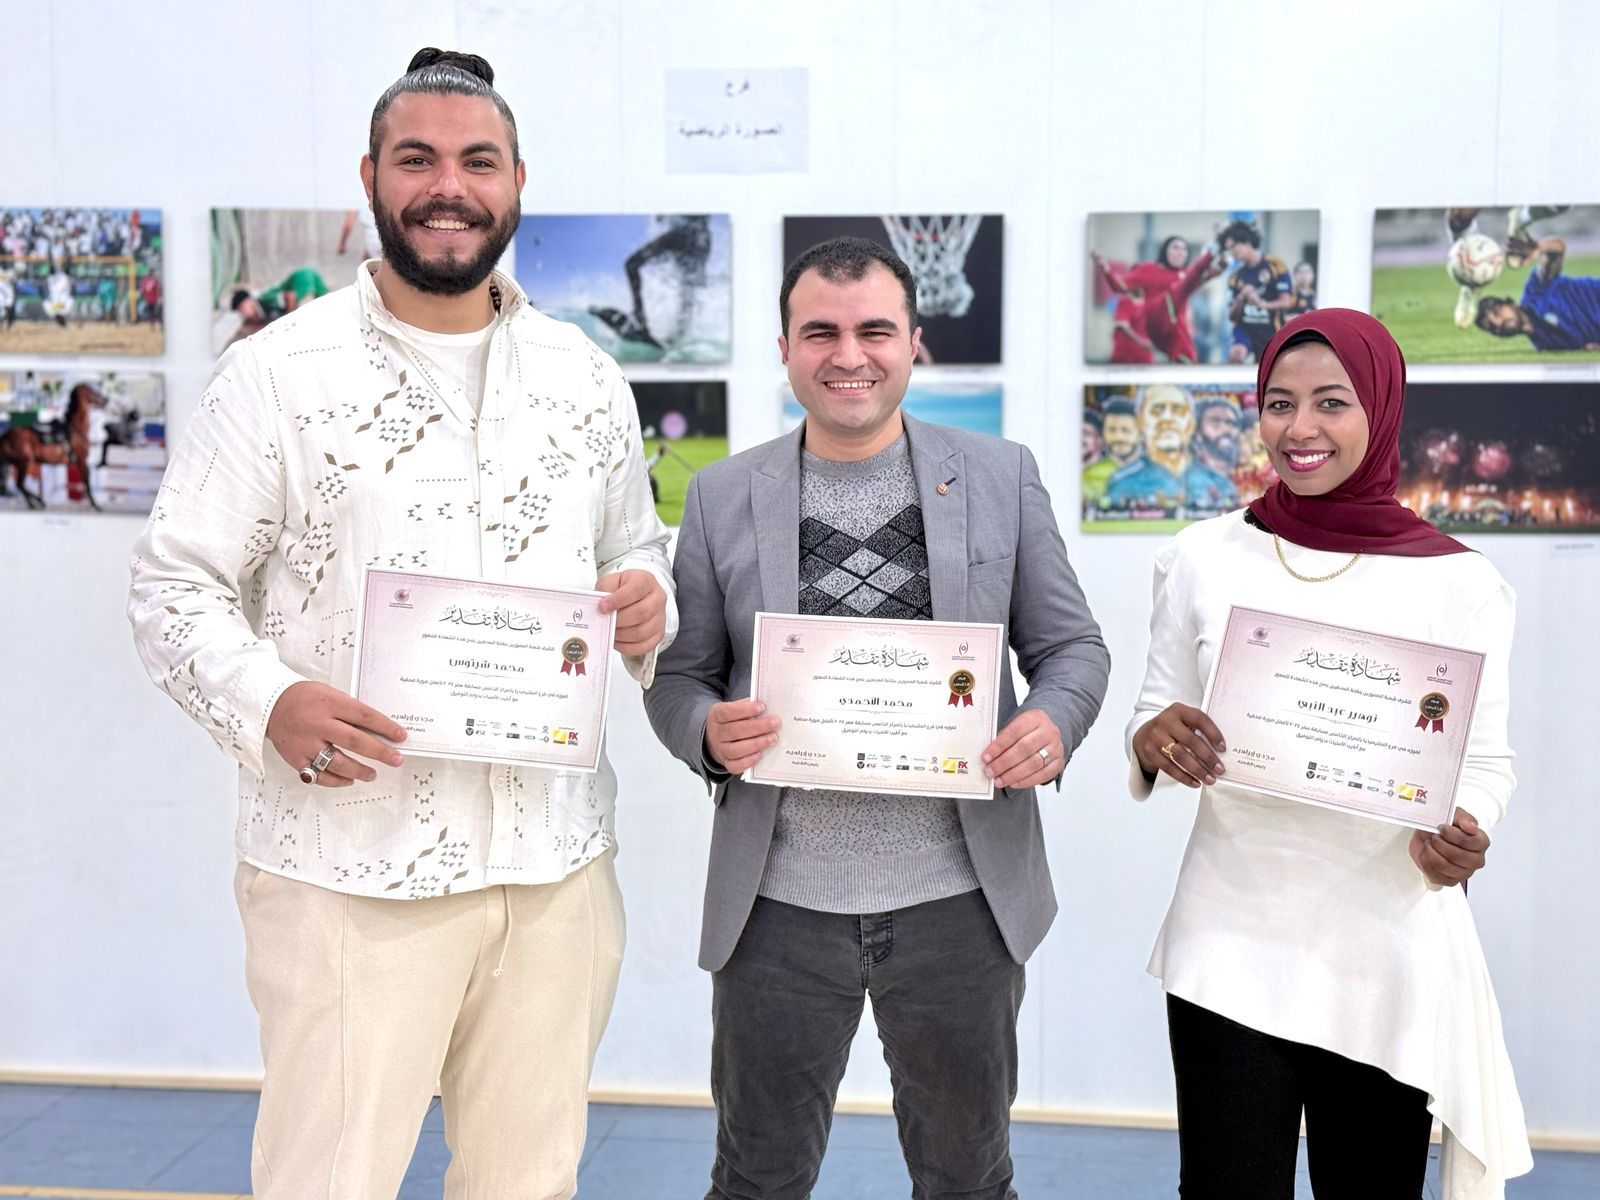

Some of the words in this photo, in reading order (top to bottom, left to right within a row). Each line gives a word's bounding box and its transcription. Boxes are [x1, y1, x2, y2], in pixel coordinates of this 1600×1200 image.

[493, 663, 524, 672] محمد
[884, 699, 912, 707] محمد
[1327, 706, 1345, 716] عبد
